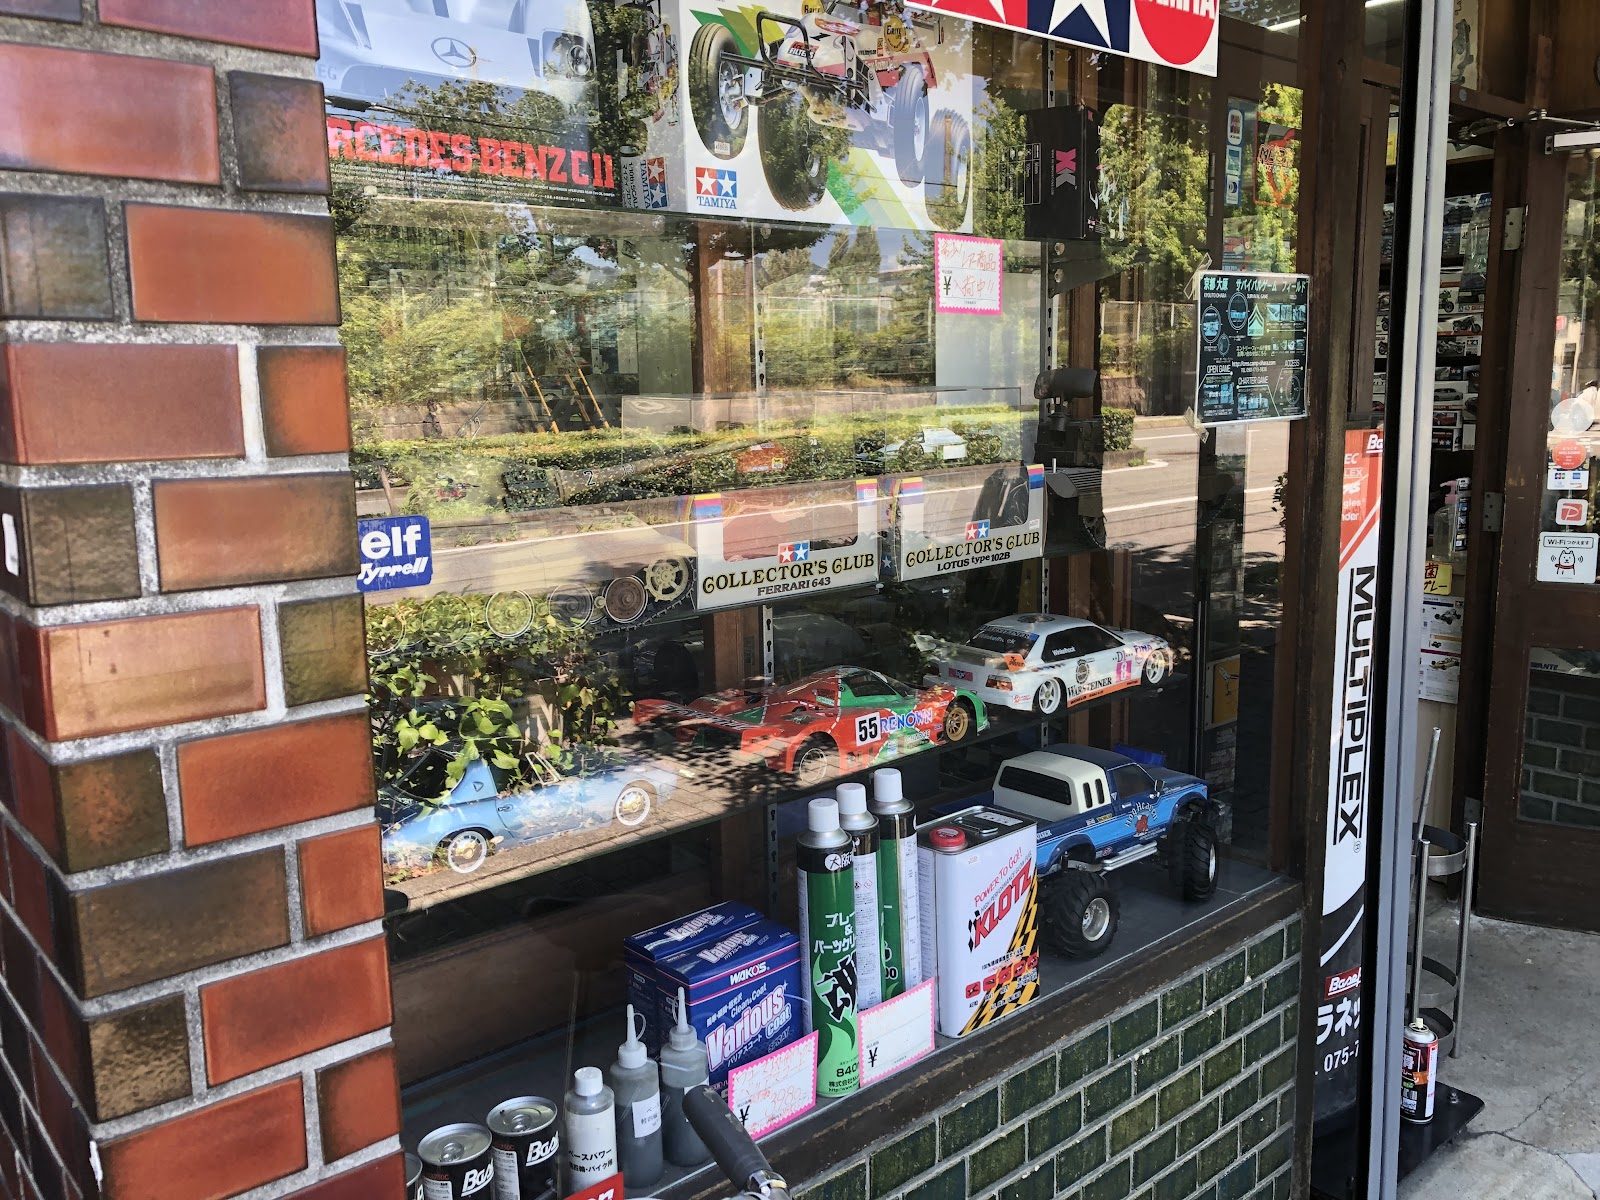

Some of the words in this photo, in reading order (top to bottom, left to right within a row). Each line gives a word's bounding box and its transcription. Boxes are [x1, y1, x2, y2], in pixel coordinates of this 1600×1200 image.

[640, 159, 651, 209] TAMIYA
[696, 195, 738, 210] TAMIYA
[361, 525, 422, 560] elf
[905, 536, 1003, 568] COLLECTOR'S
[1006, 531, 1040, 550] CLUB
[357, 556, 429, 585] Tyrrell
[702, 560, 828, 594] COLLECTOR'S
[832, 553, 874, 574] CLUB
[937, 557, 970, 572] LOTUS
[971, 554, 990, 566] type
[991, 551, 1011, 562] 102B
[757, 579, 810, 597] FERRARI
[811, 576, 831, 588] 643
[1067, 676, 1113, 698] WARSTEINER
[1338, 565, 1376, 844] MULTIPLEX
[858, 717, 878, 742] 55
[880, 708, 933, 733] RENOWN
[973, 857, 1033, 949] KLOTZ
[844, 923, 853, 936] &
[696, 931, 748, 964] Various
[731, 999, 750, 1018] Clean
[751, 982, 767, 1000] Coat
[705, 985, 786, 1072] Various
[868, 1047, 878, 1067] ¥
